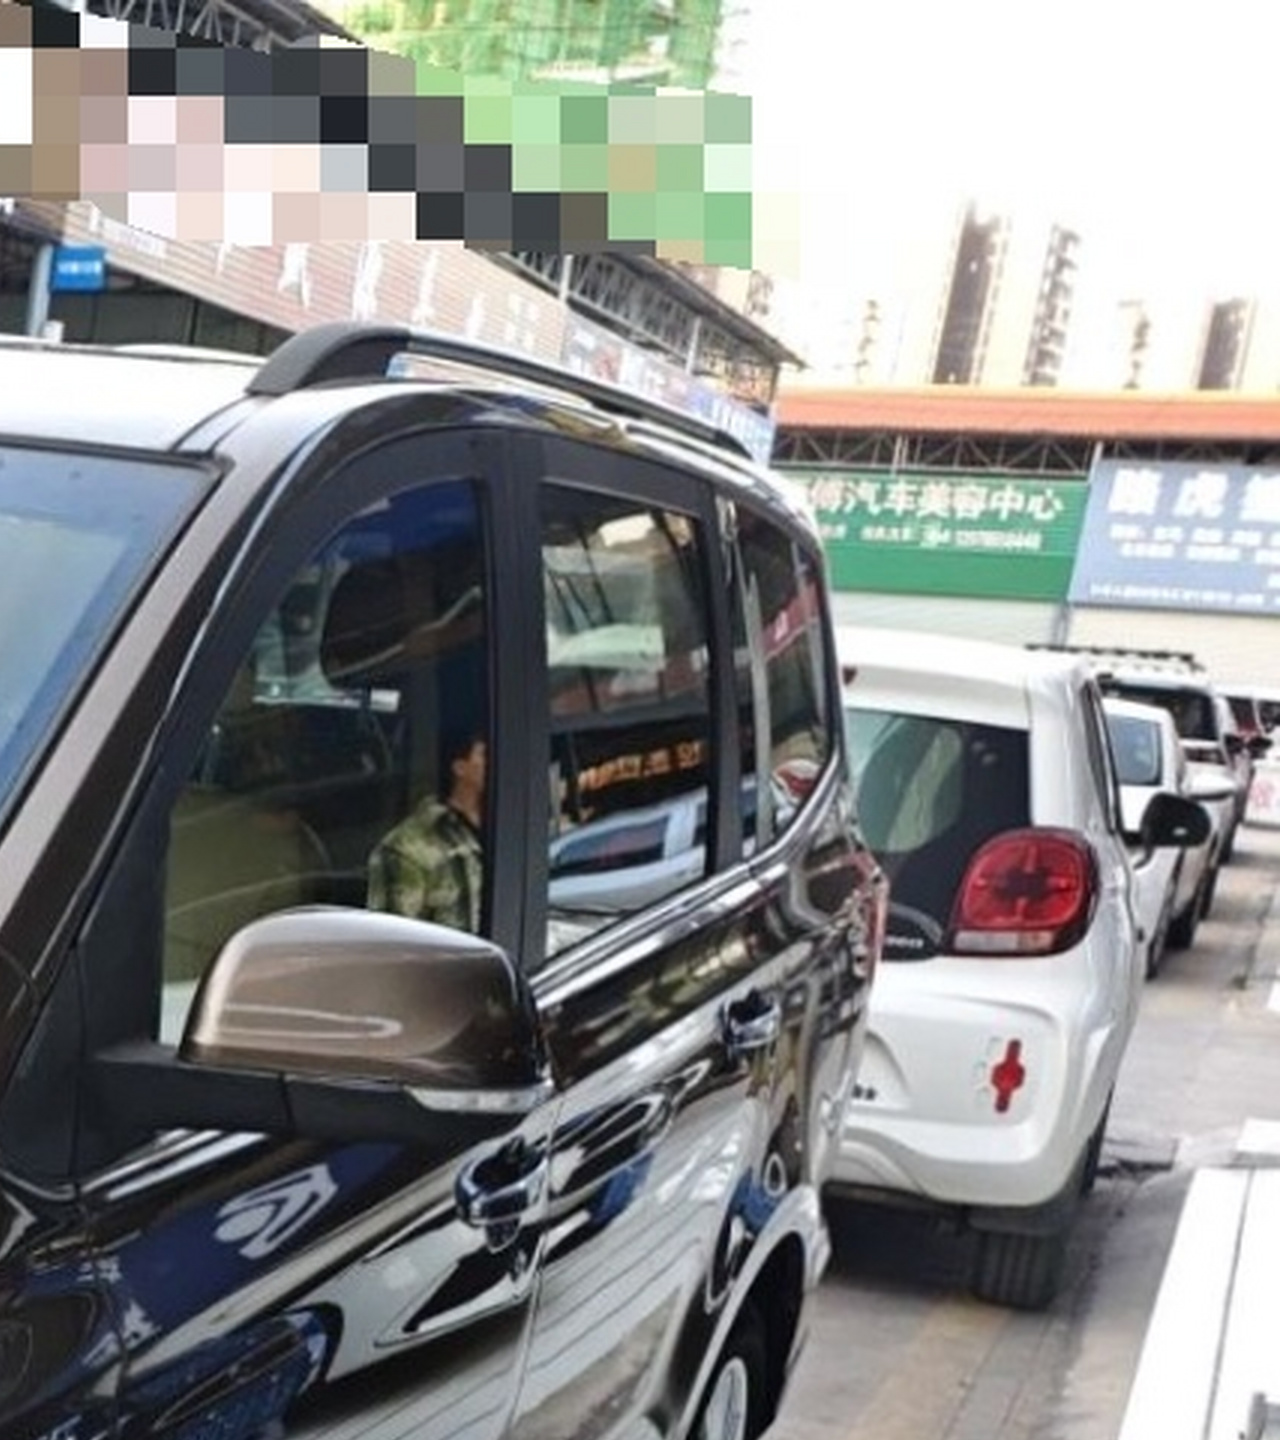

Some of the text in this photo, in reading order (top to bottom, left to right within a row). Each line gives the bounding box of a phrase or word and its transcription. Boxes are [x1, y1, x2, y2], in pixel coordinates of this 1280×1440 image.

[798, 475, 1064, 522] 傅汽车美容中心
